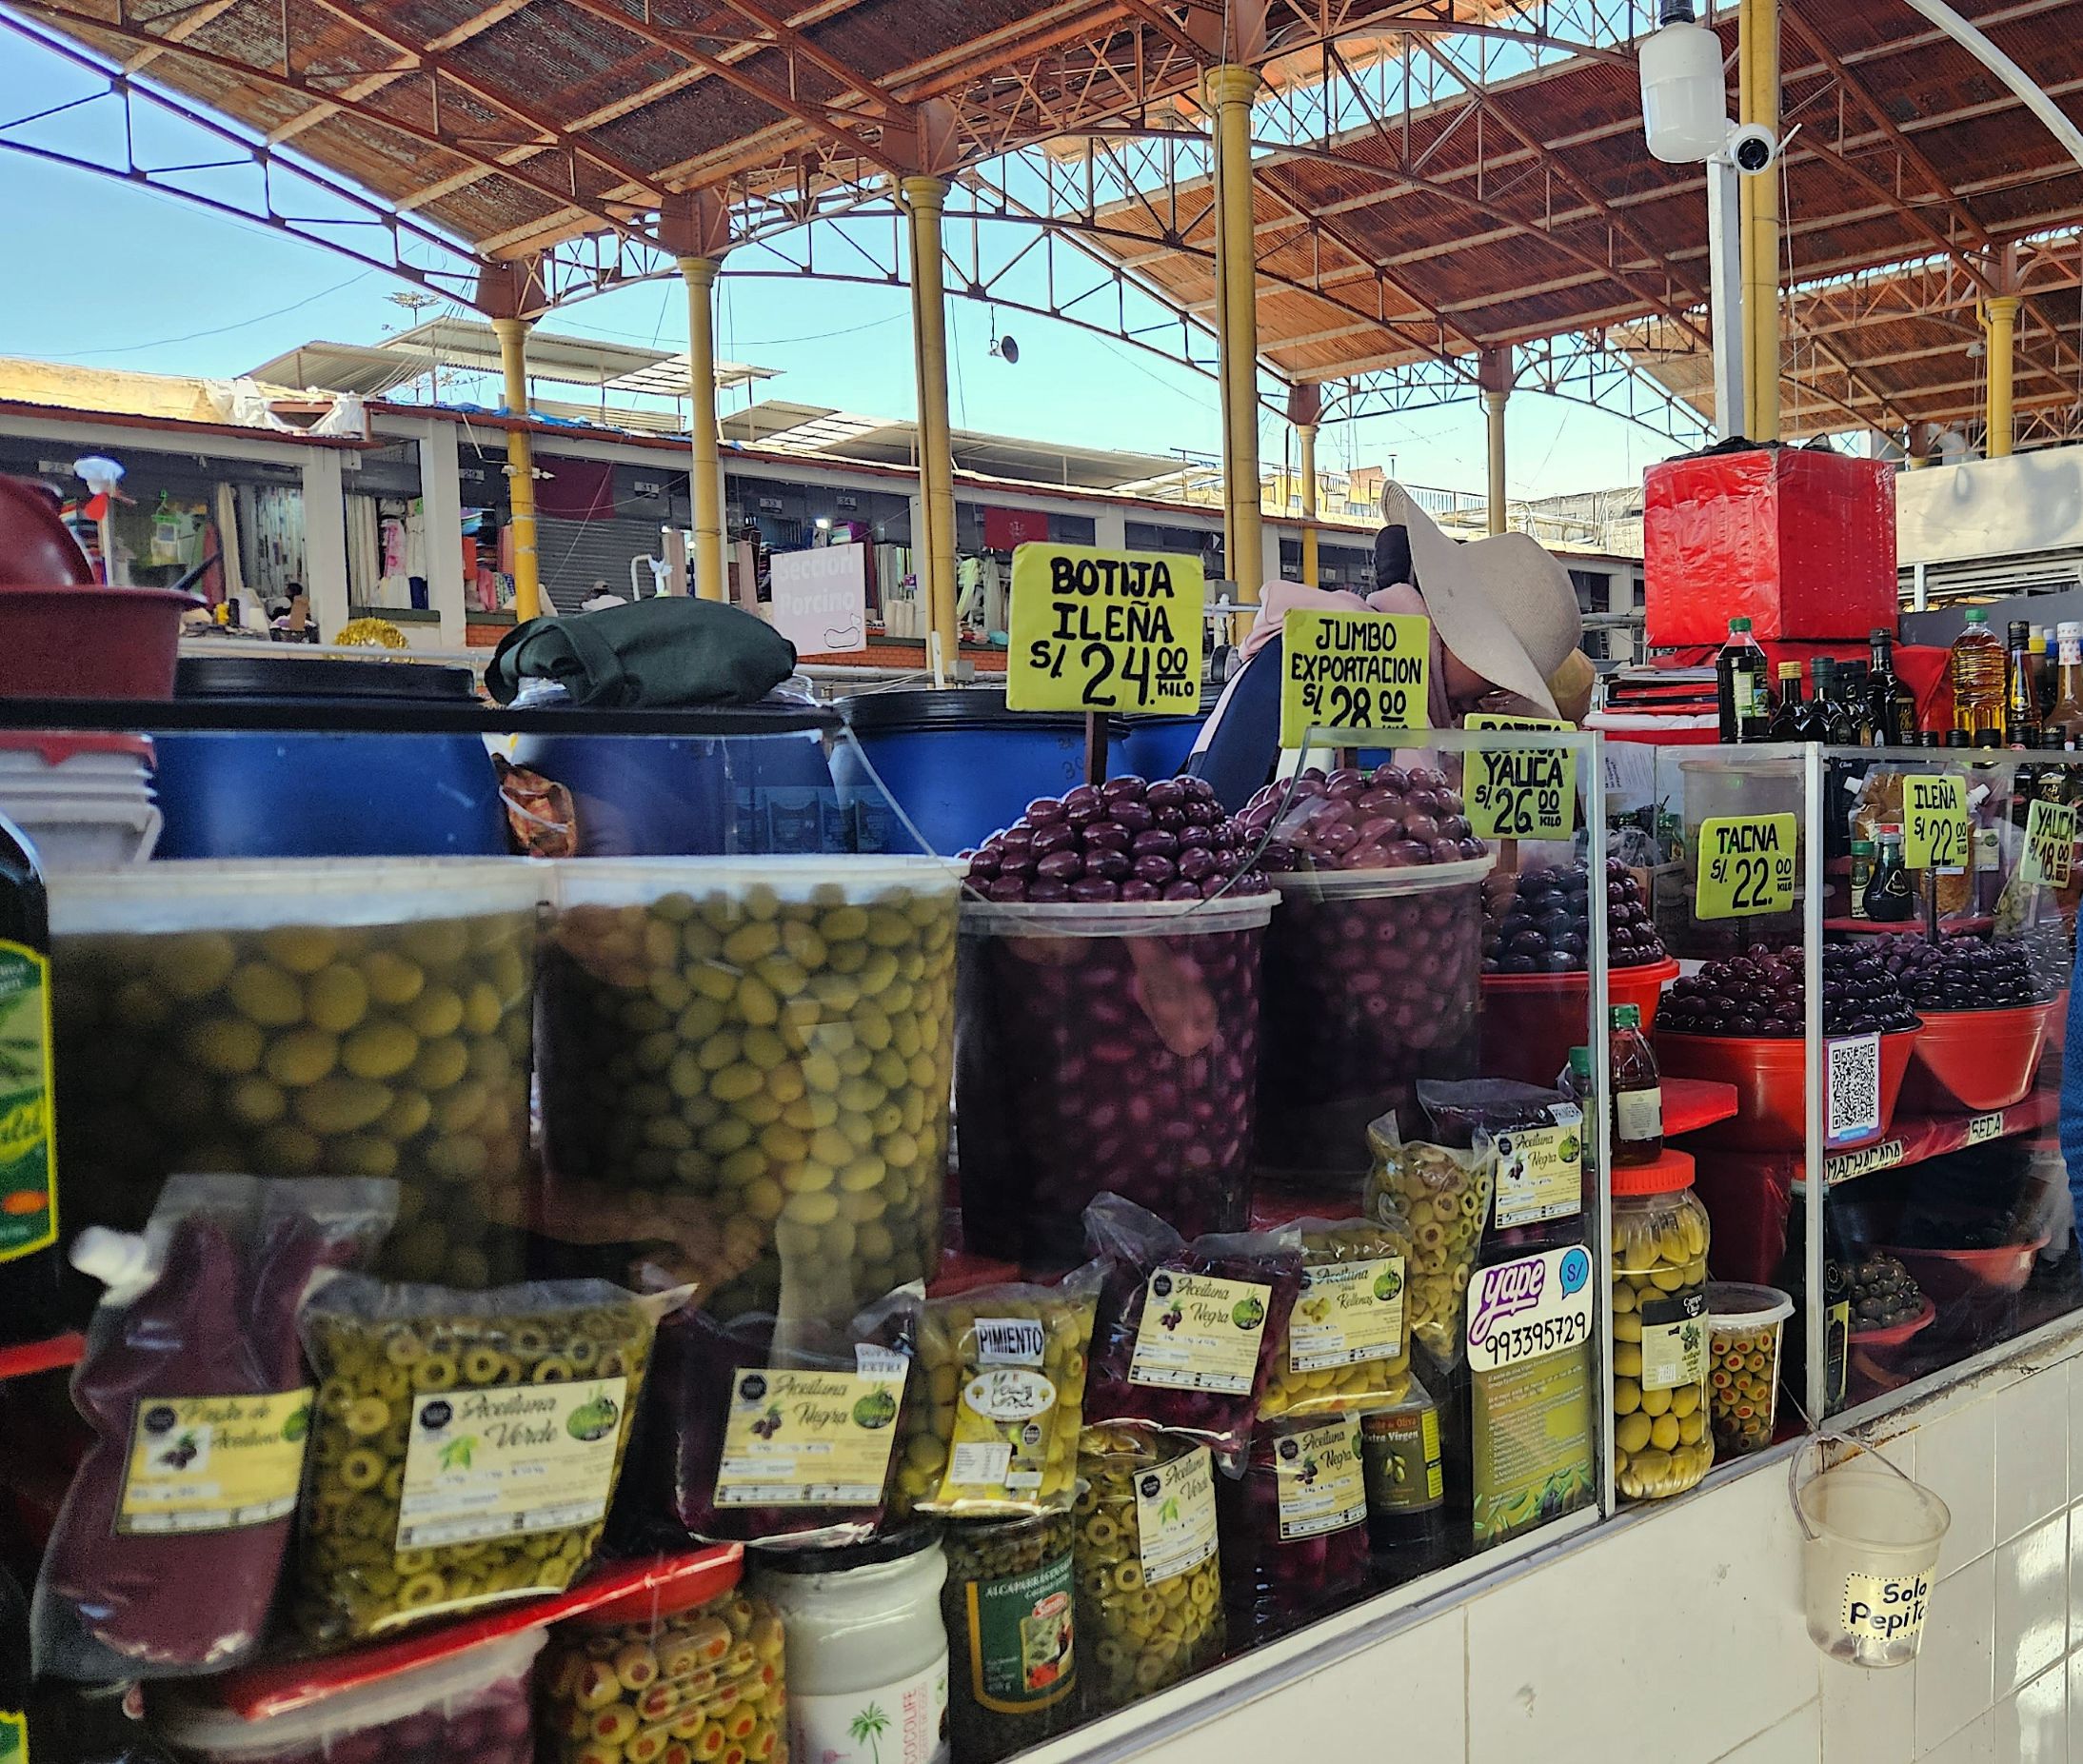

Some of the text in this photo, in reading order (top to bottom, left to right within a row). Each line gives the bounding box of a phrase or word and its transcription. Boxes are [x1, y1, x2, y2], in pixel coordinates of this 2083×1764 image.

[1050, 557, 1175, 598] BOTIJA
[779, 587, 855, 616] Porcino
[1052, 601, 1174, 643] ILEÑA
[1316, 619, 1397, 652] JUMBO
[1291, 653, 1422, 684] EXPORTACION
[1158, 681, 1194, 697] KILO
[1482, 753, 1564, 788] YAUCA
[1914, 779, 1957, 809] ILEÑA
[1539, 816, 1562, 827] KILO
[2035, 805, 2074, 842] YAUCA
[1716, 823, 1778, 854] TACNA
[1776, 882, 1793, 892] KILO
[1972, 1114, 2000, 1139] SECA
[1515, 1131, 1554, 1150] Aceituna
[1528, 1151, 1557, 1171] Negra
[1827, 1142, 1900, 1180] MACHACADA
[1567, 1261, 1584, 1282] S/
[1176, 1278, 1230, 1300] Aceituna
[1190, 1302, 1230, 1328] Negra
[980, 1326, 1043, 1356] PIMIENTO
[1485, 1312, 1585, 1365] 993395729
[772, 1376, 848, 1397] Aceituna
[1301, 1430, 1345, 1452] Aceituna
[1388, 1430, 1418, 1442] Virgen
[1319, 1449, 1352, 1471] Negra
[1883, 1577, 1927, 1604] Solo
